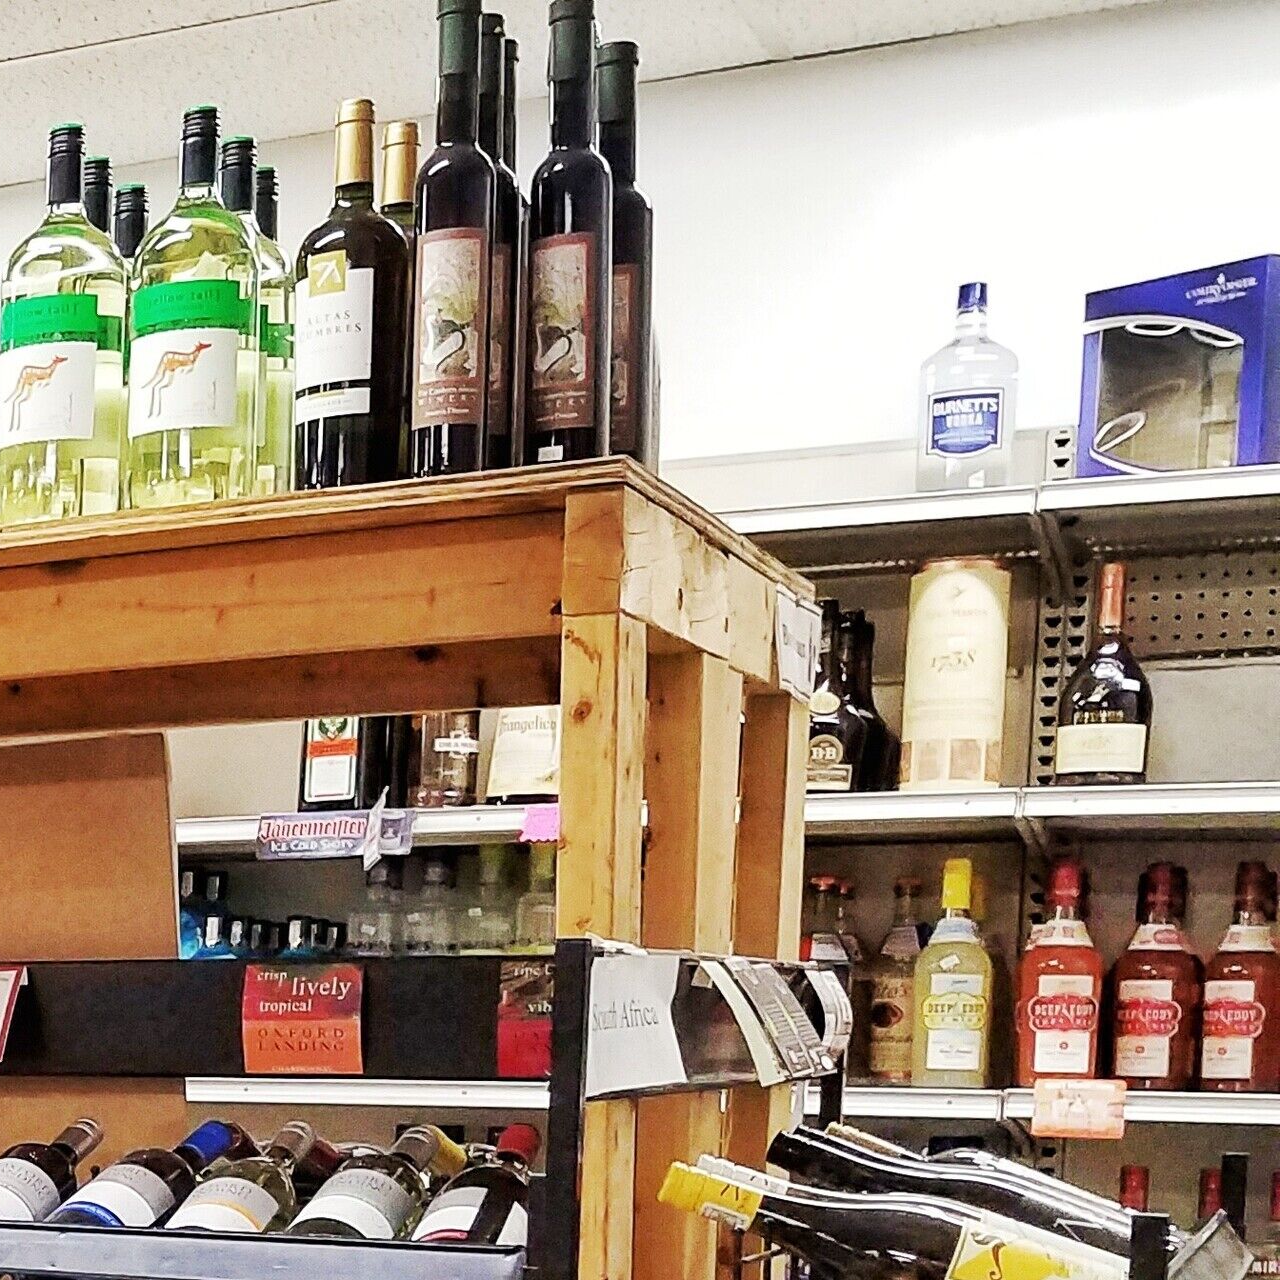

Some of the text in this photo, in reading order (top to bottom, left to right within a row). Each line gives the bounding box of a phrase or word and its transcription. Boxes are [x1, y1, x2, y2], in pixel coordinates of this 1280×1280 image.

[257, 970, 352, 1000] crisp lively
[259, 999, 312, 1017] tropical
[620, 998, 660, 1027] Africa
[257, 1028, 345, 1040] OXFORD
[257, 1040, 345, 1052] LANDING
